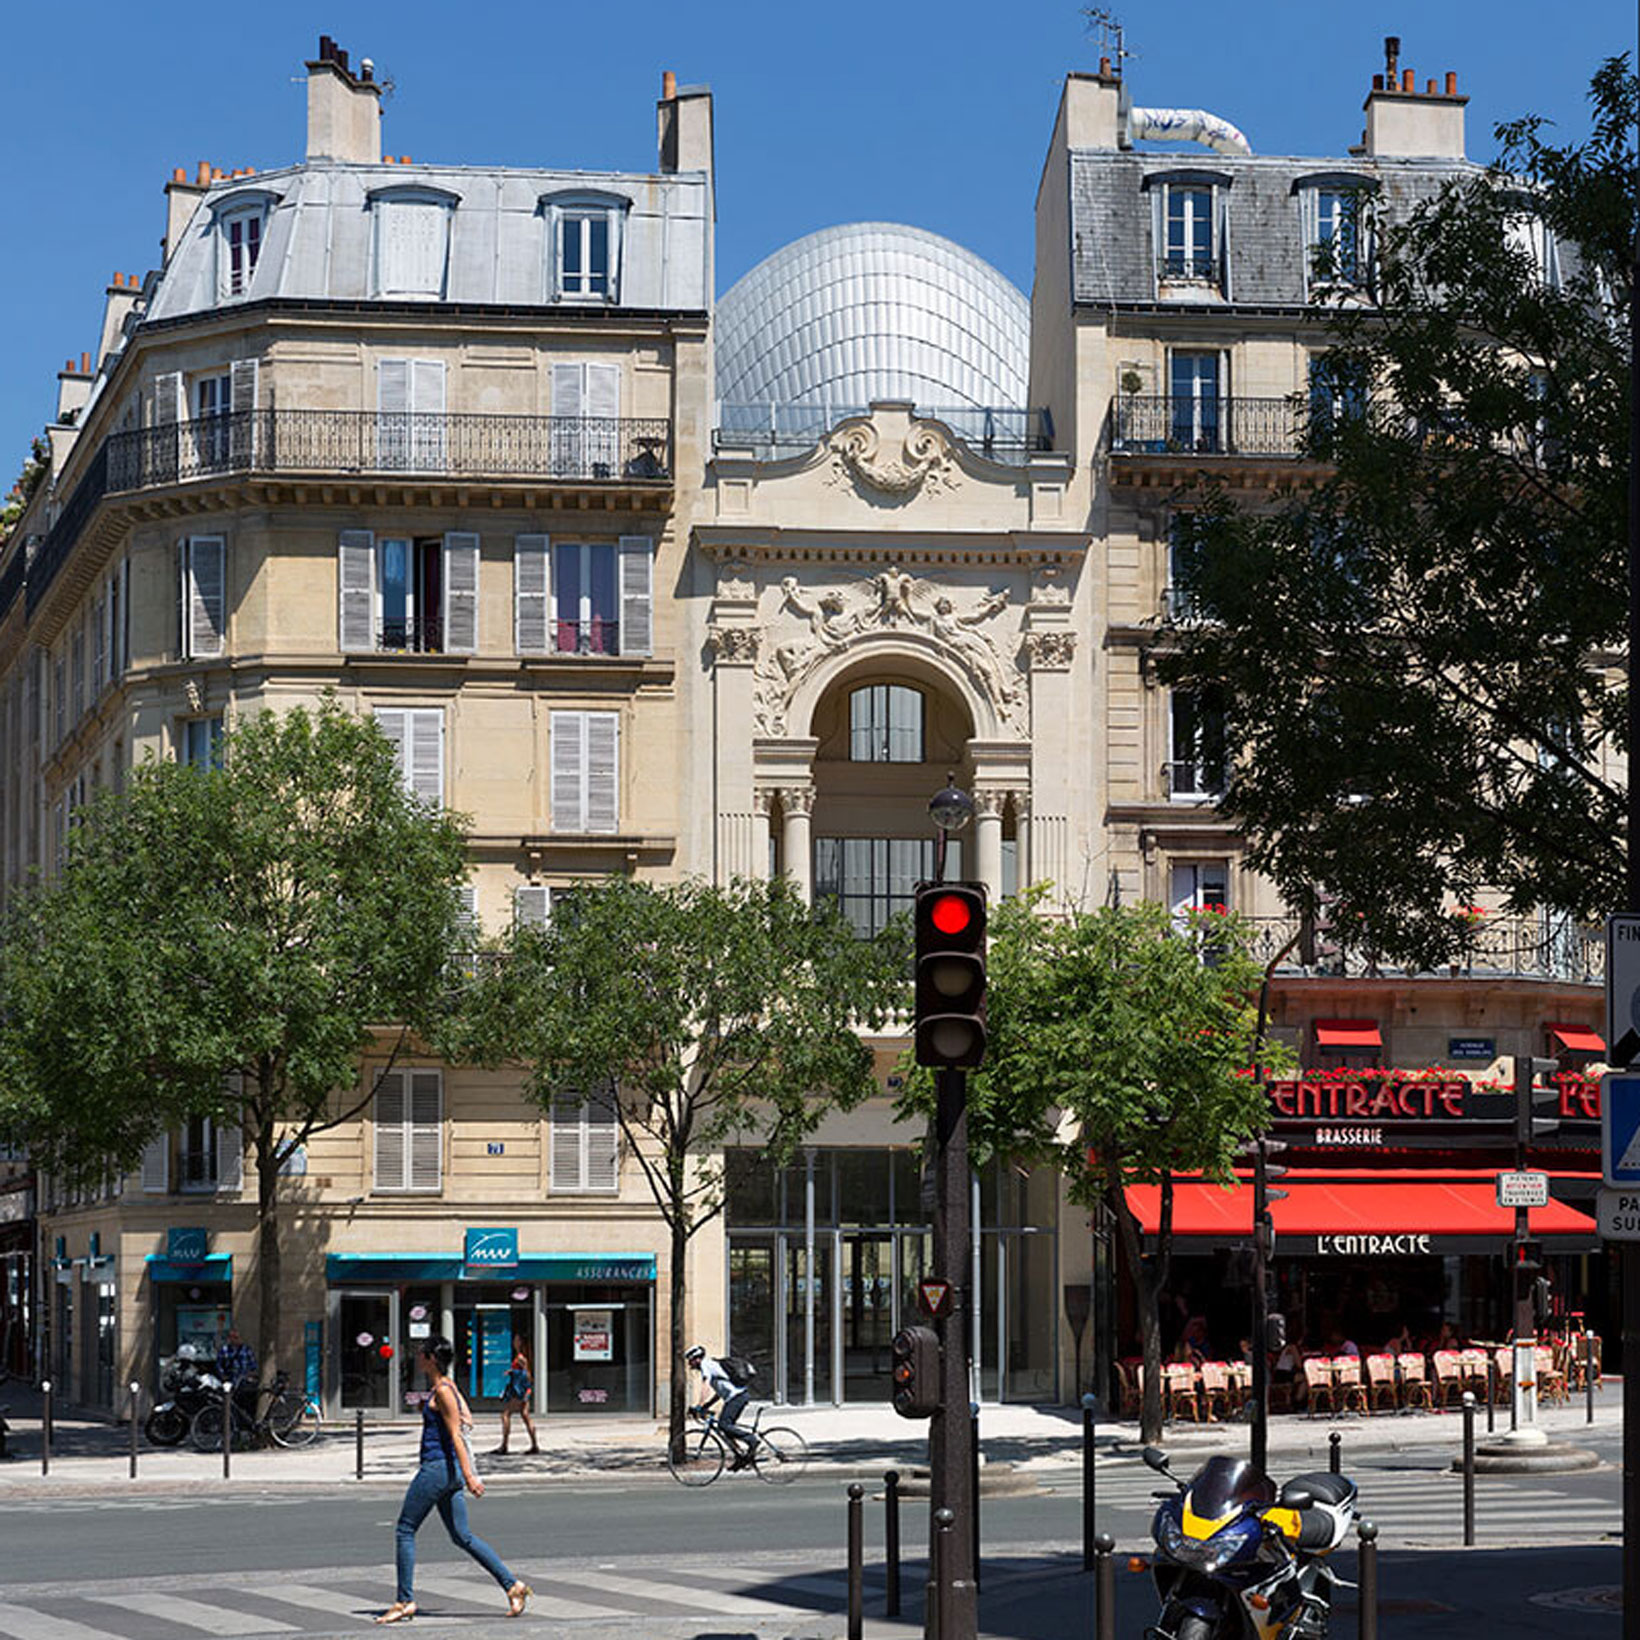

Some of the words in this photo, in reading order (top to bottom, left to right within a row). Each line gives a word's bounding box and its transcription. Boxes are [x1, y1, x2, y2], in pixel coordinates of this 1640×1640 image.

[1315, 1127, 1383, 1145] BRASSERIE
[1612, 1216, 1640, 1231] SU
[1317, 1234, 1431, 1255] L'ENTRACTE
